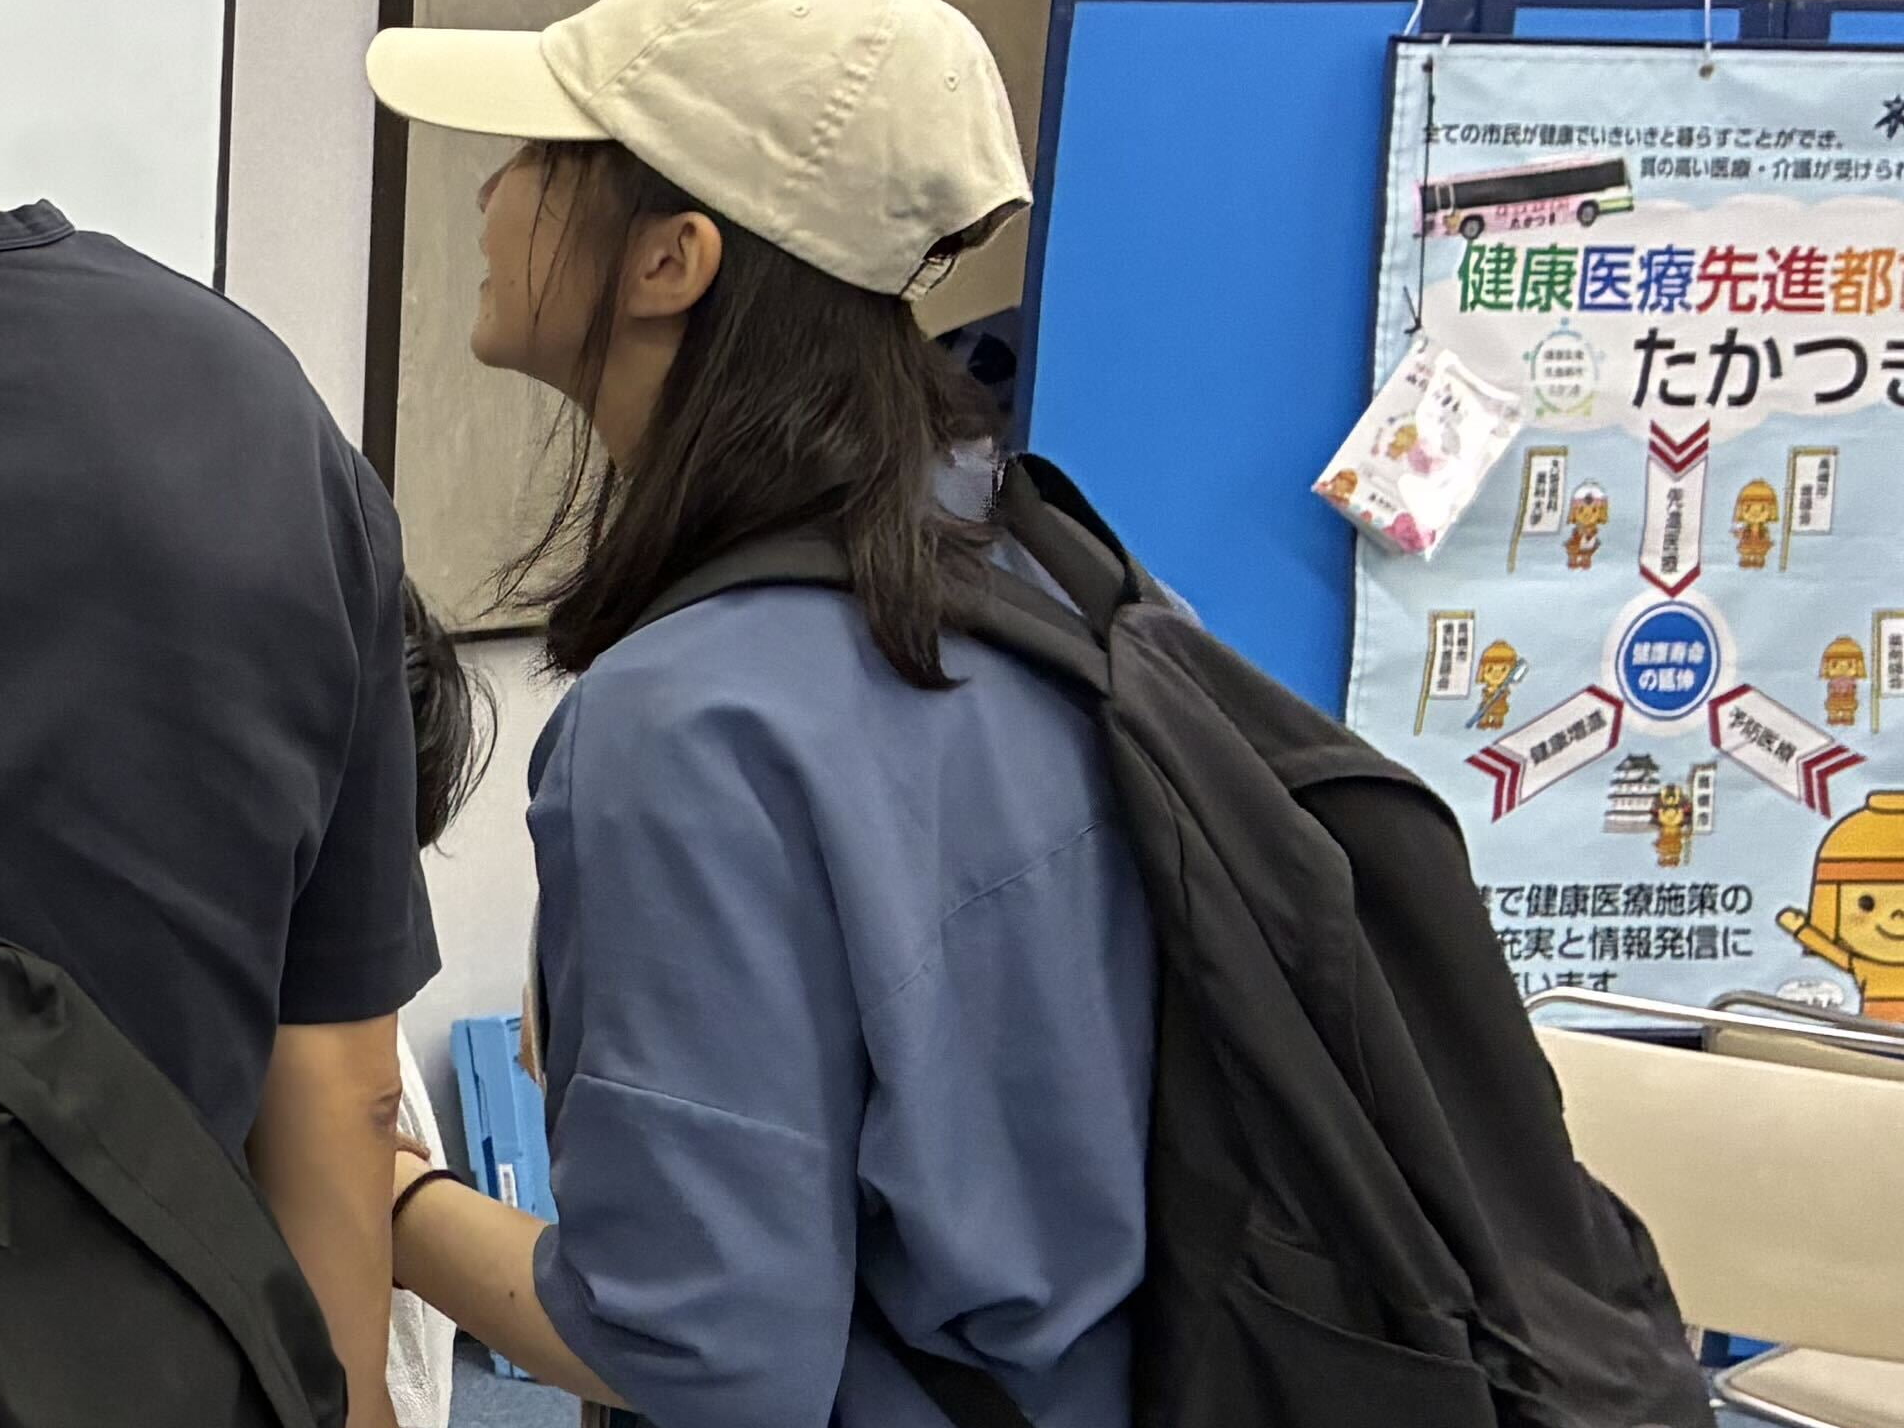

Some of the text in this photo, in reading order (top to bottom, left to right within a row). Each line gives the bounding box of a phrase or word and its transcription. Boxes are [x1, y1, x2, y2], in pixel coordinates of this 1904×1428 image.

[1640, 155, 1904, 182] 質の高い医療・介護が受けら
[1457, 243, 1904, 315] 健康医療先進都
